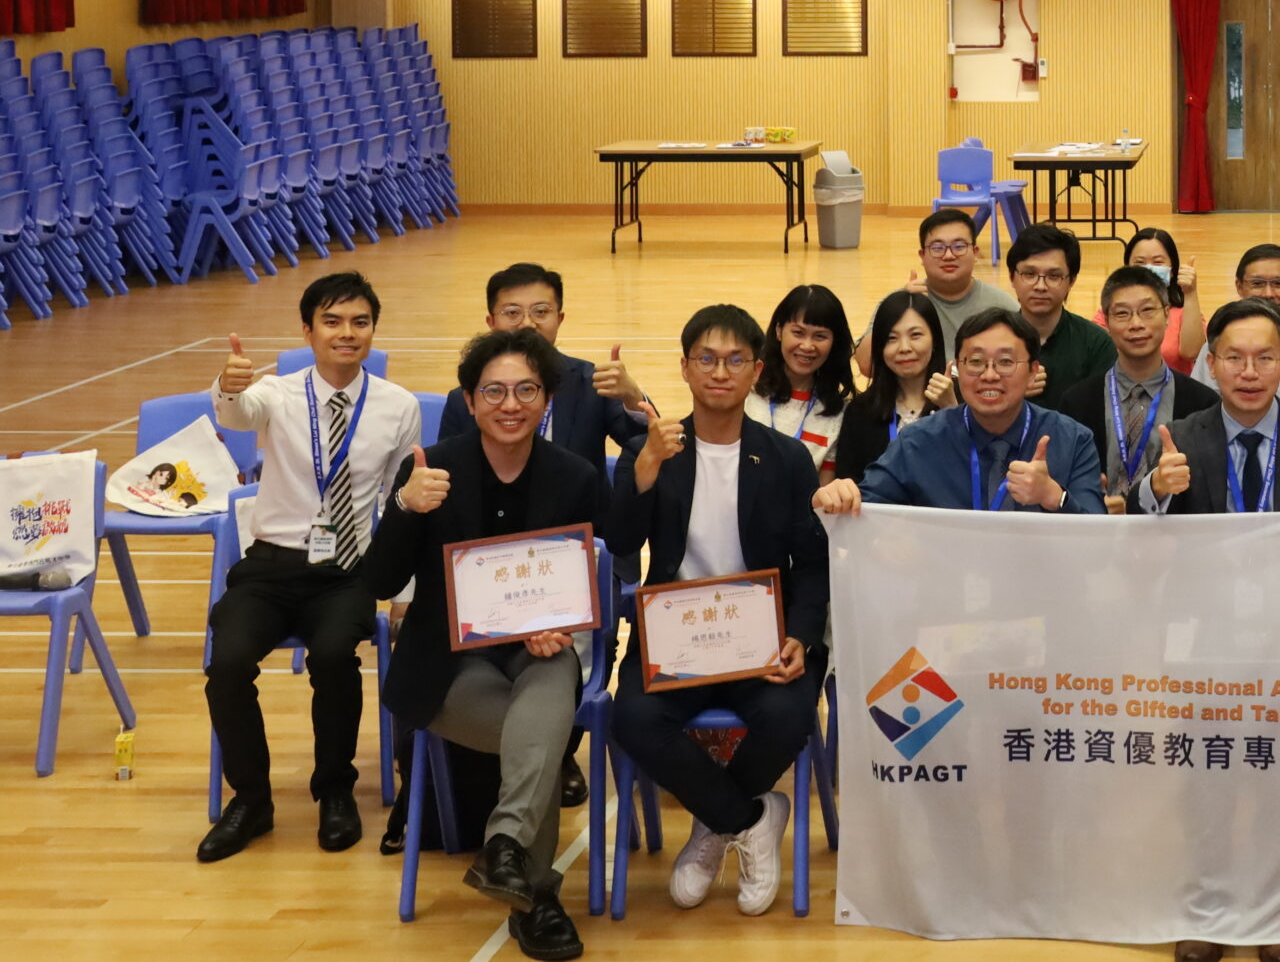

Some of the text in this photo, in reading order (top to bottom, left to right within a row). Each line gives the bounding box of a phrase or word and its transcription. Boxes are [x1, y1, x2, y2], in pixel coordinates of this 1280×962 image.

[494, 559, 554, 583] 感謝狀
[682, 604, 741, 626] 感謝狀
[988, 672, 1048, 694] Hong
[1055, 673, 1114, 695] Kong
[1122, 674, 1264, 697] Professional
[1042, 698, 1073, 715] for
[1081, 699, 1118, 716] the
[1125, 699, 1194, 720] Gifted
[1201, 703, 1243, 722] and
